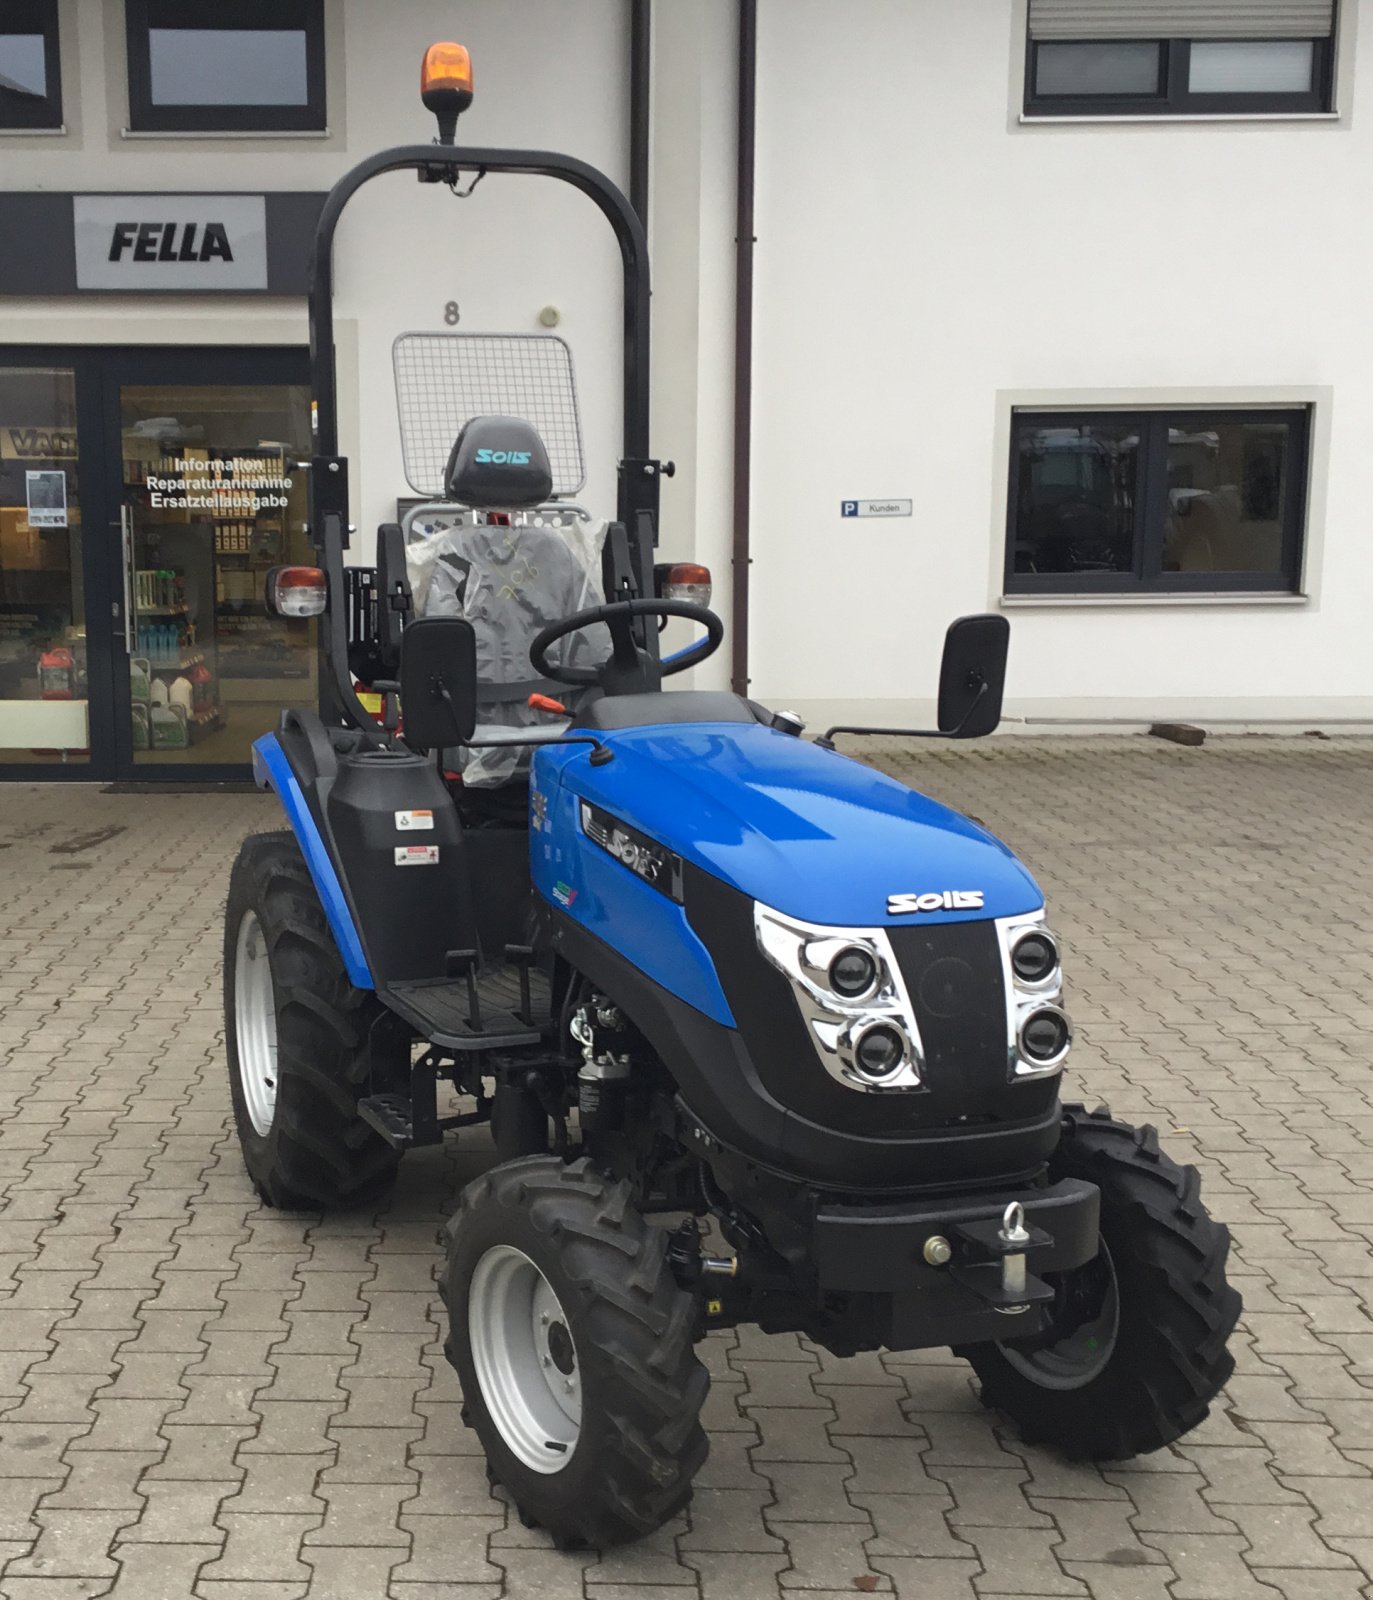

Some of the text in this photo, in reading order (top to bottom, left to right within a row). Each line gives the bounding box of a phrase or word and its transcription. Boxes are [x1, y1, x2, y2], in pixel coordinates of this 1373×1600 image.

[108, 222, 234, 262] FELLA
[444, 300, 460, 326] 8
[174, 457, 263, 472] Information
[146, 476, 293, 492] Reparaturannahme
[150, 492, 289, 510] Ersatzteilausgabe
[844, 502, 900, 516] P Kunden
